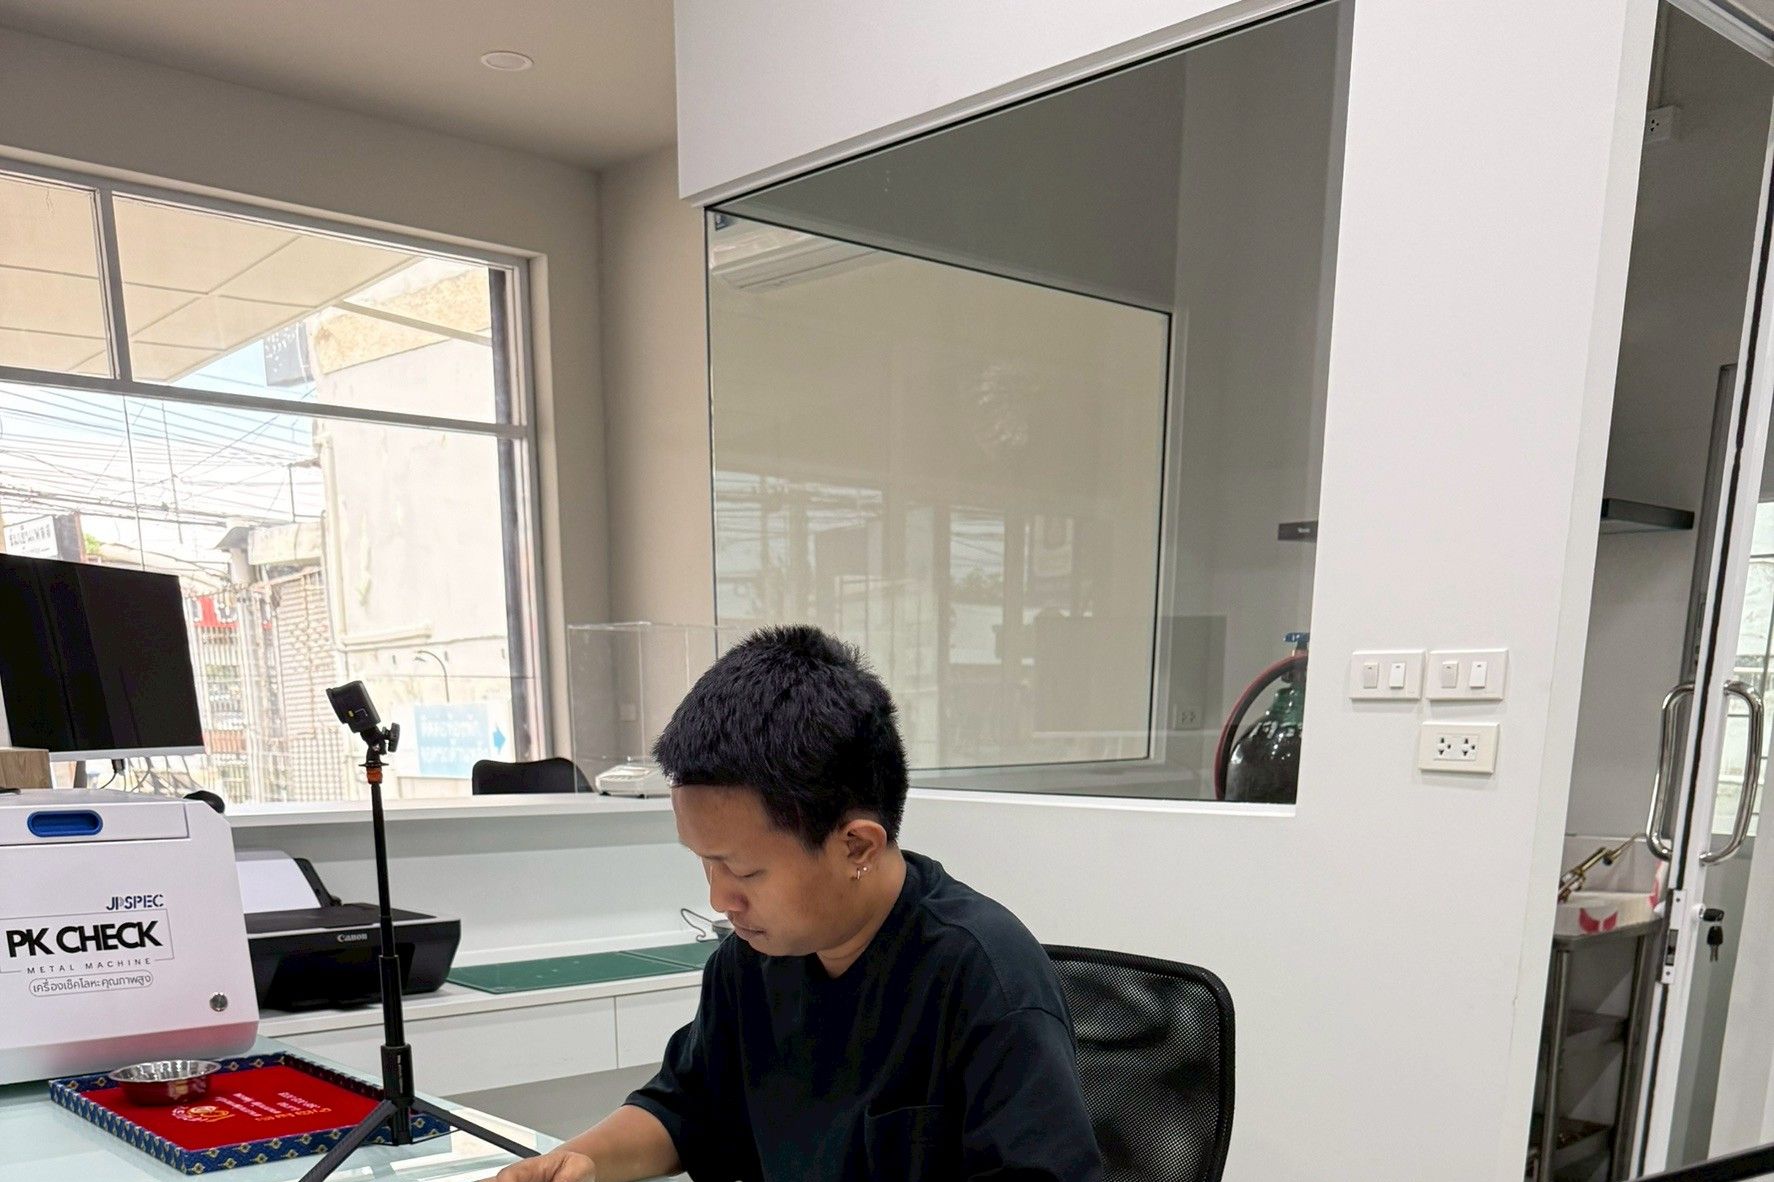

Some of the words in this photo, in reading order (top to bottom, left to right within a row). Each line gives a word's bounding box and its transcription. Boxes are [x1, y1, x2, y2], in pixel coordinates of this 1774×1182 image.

[6, 928, 55, 957] PK
[56, 921, 163, 953] CHECK
[27, 964, 75, 974] METAL
[85, 958, 151, 970] MACHINE
